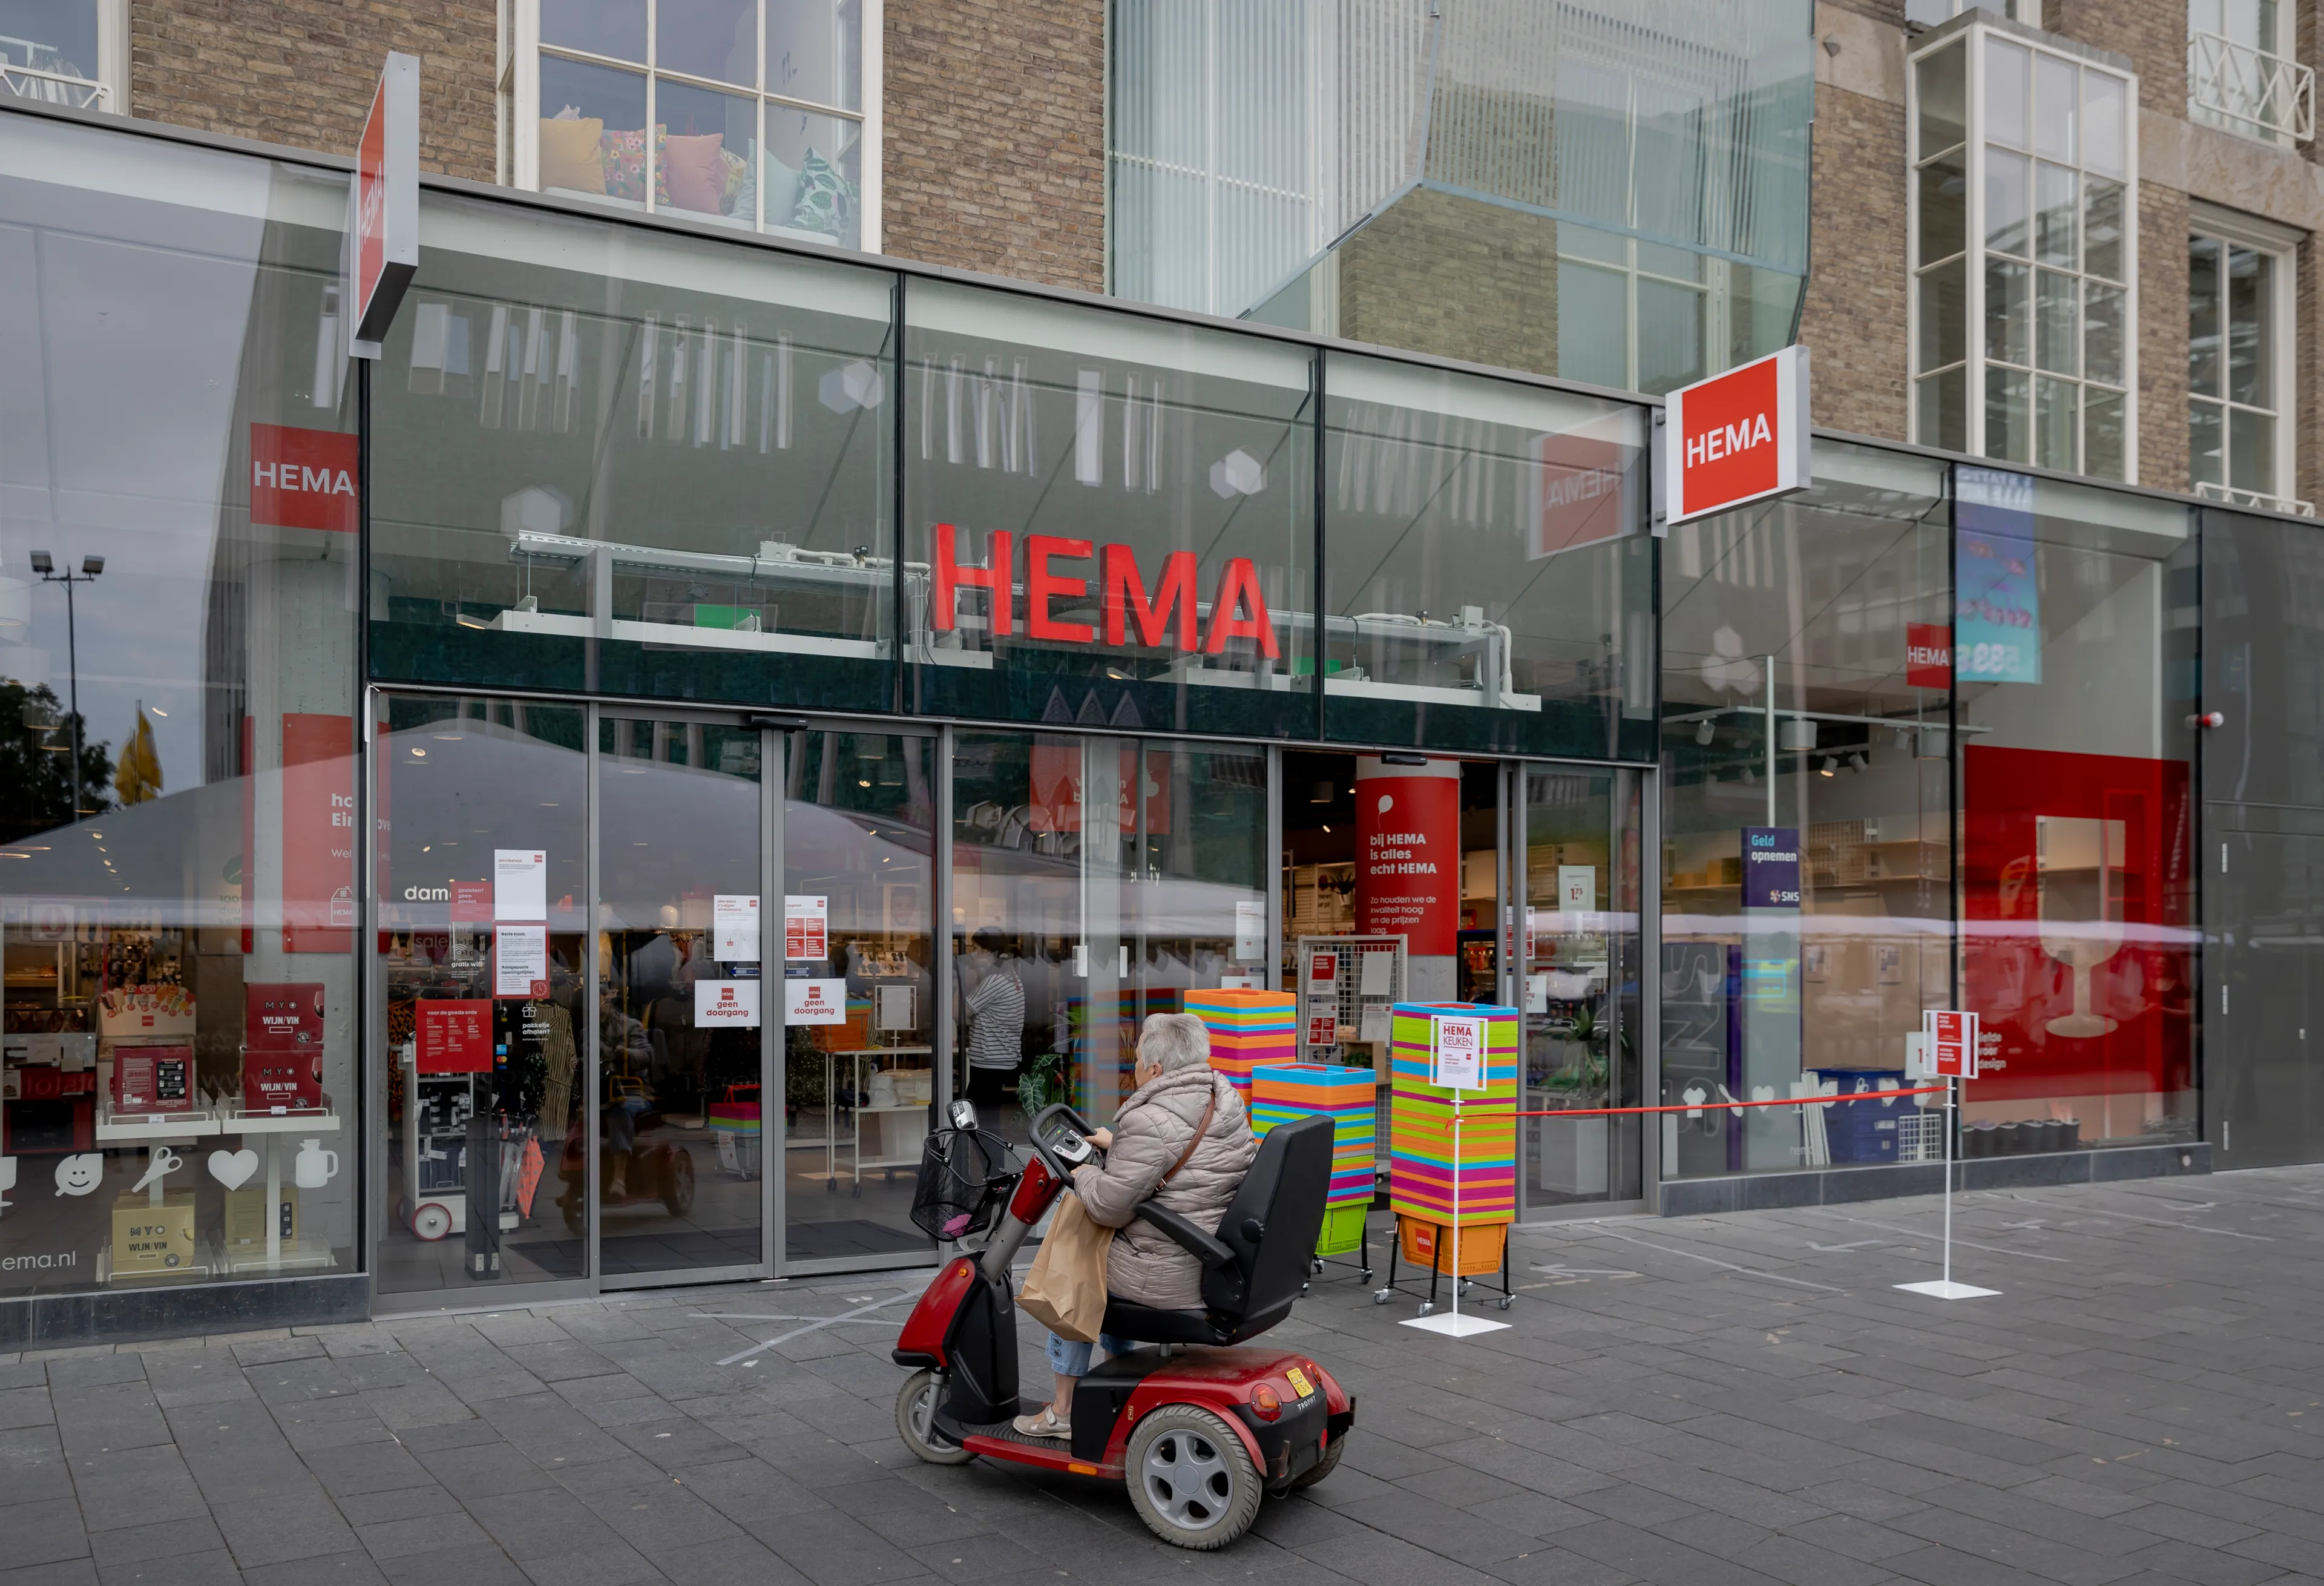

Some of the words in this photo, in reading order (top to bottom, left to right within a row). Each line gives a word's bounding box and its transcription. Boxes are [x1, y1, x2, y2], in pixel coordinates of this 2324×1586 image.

[361, 159, 382, 253] HEMA
[1687, 413, 1772, 469] HEMA
[255, 461, 355, 496] HEMA
[930, 523, 1281, 659] HEMA
[1908, 646, 1949, 666] HEMA
[1370, 834, 1384, 847] bij
[1387, 834, 1426, 844] HEMA
[1751, 834, 1774, 846] Geld
[1370, 849, 1378, 860] is
[1380, 849, 1411, 860] alles
[1751, 851, 1797, 863] opnemen
[1370, 864, 1396, 875] echt
[1398, 863, 1437, 874] HEMA
[1781, 891, 1799, 901] SNS
[1401, 906, 1424, 915] hoog
[1391, 916, 1419, 926] prijzen
[415, 935, 448, 947] sale
[1444, 1025, 1472, 1036] HEMA
[1443, 1036, 1472, 1047] KEUKEN
[129, 1242, 167, 1251] WIJN/VIN
[1417, 1237, 1431, 1246] HEMA
[1297, 1395, 1316, 1410] TROPHY
